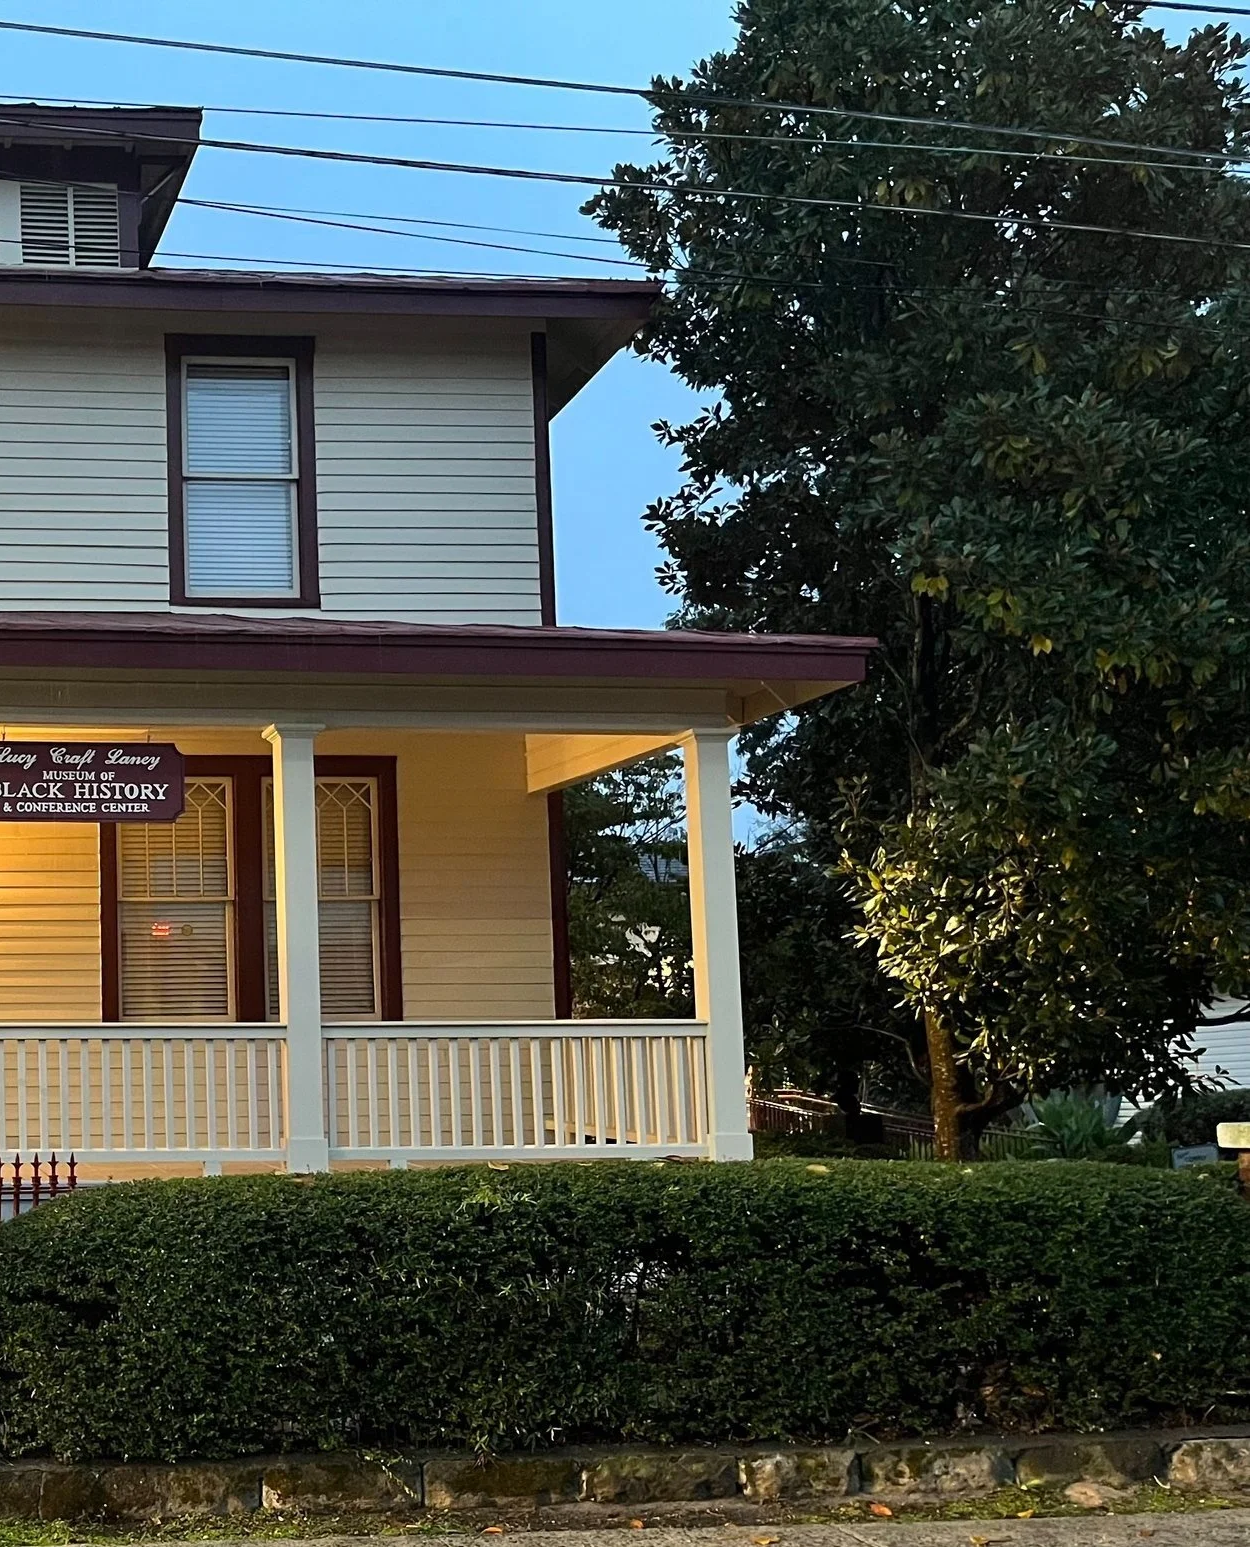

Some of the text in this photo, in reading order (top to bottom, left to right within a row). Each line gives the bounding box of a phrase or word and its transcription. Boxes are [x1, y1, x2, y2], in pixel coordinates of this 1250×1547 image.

[50, 748, 96, 770] Craft
[104, 749, 160, 770] Laney
[42, 771, 115, 781] MUSEUM OF
[73, 783, 169, 800] HISTORY
[3, 802, 150, 813] & CONFERENCE CENTER
